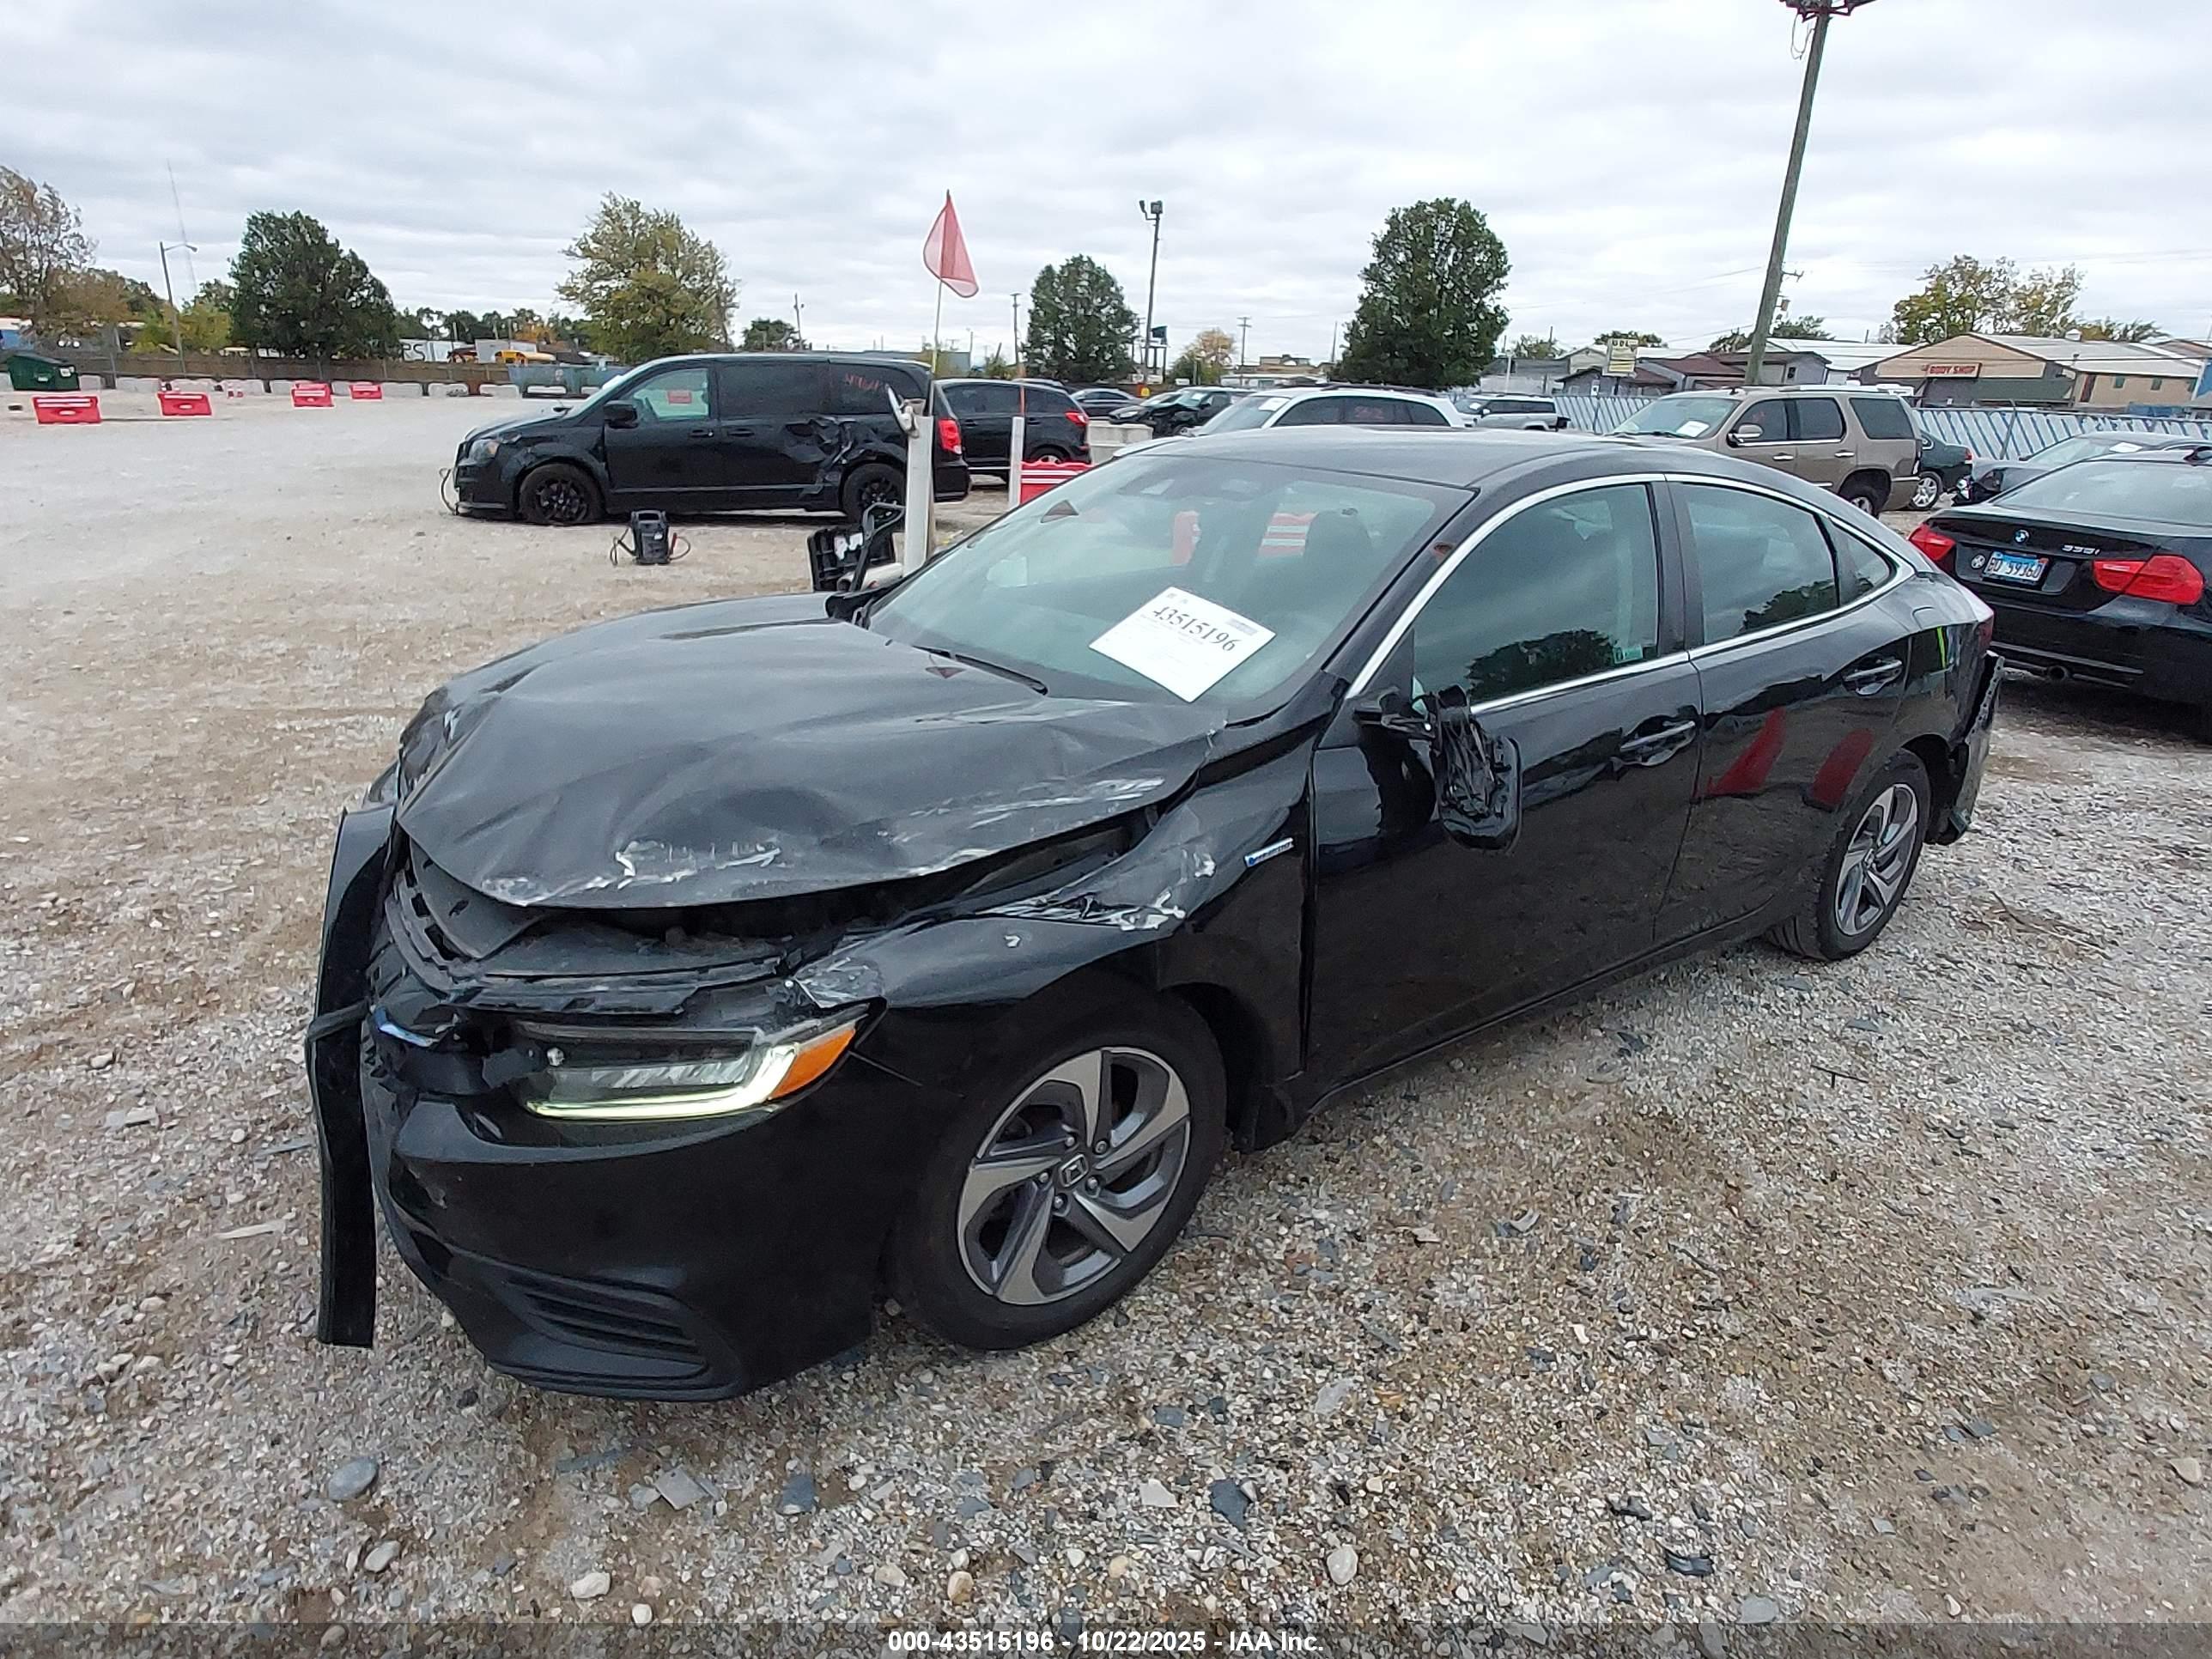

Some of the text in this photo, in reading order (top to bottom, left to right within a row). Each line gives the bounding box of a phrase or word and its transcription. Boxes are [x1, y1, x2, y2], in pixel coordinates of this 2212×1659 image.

[1929, 366, 1976, 374] BODY SHOP
[1152, 605, 1242, 652] 43515196
